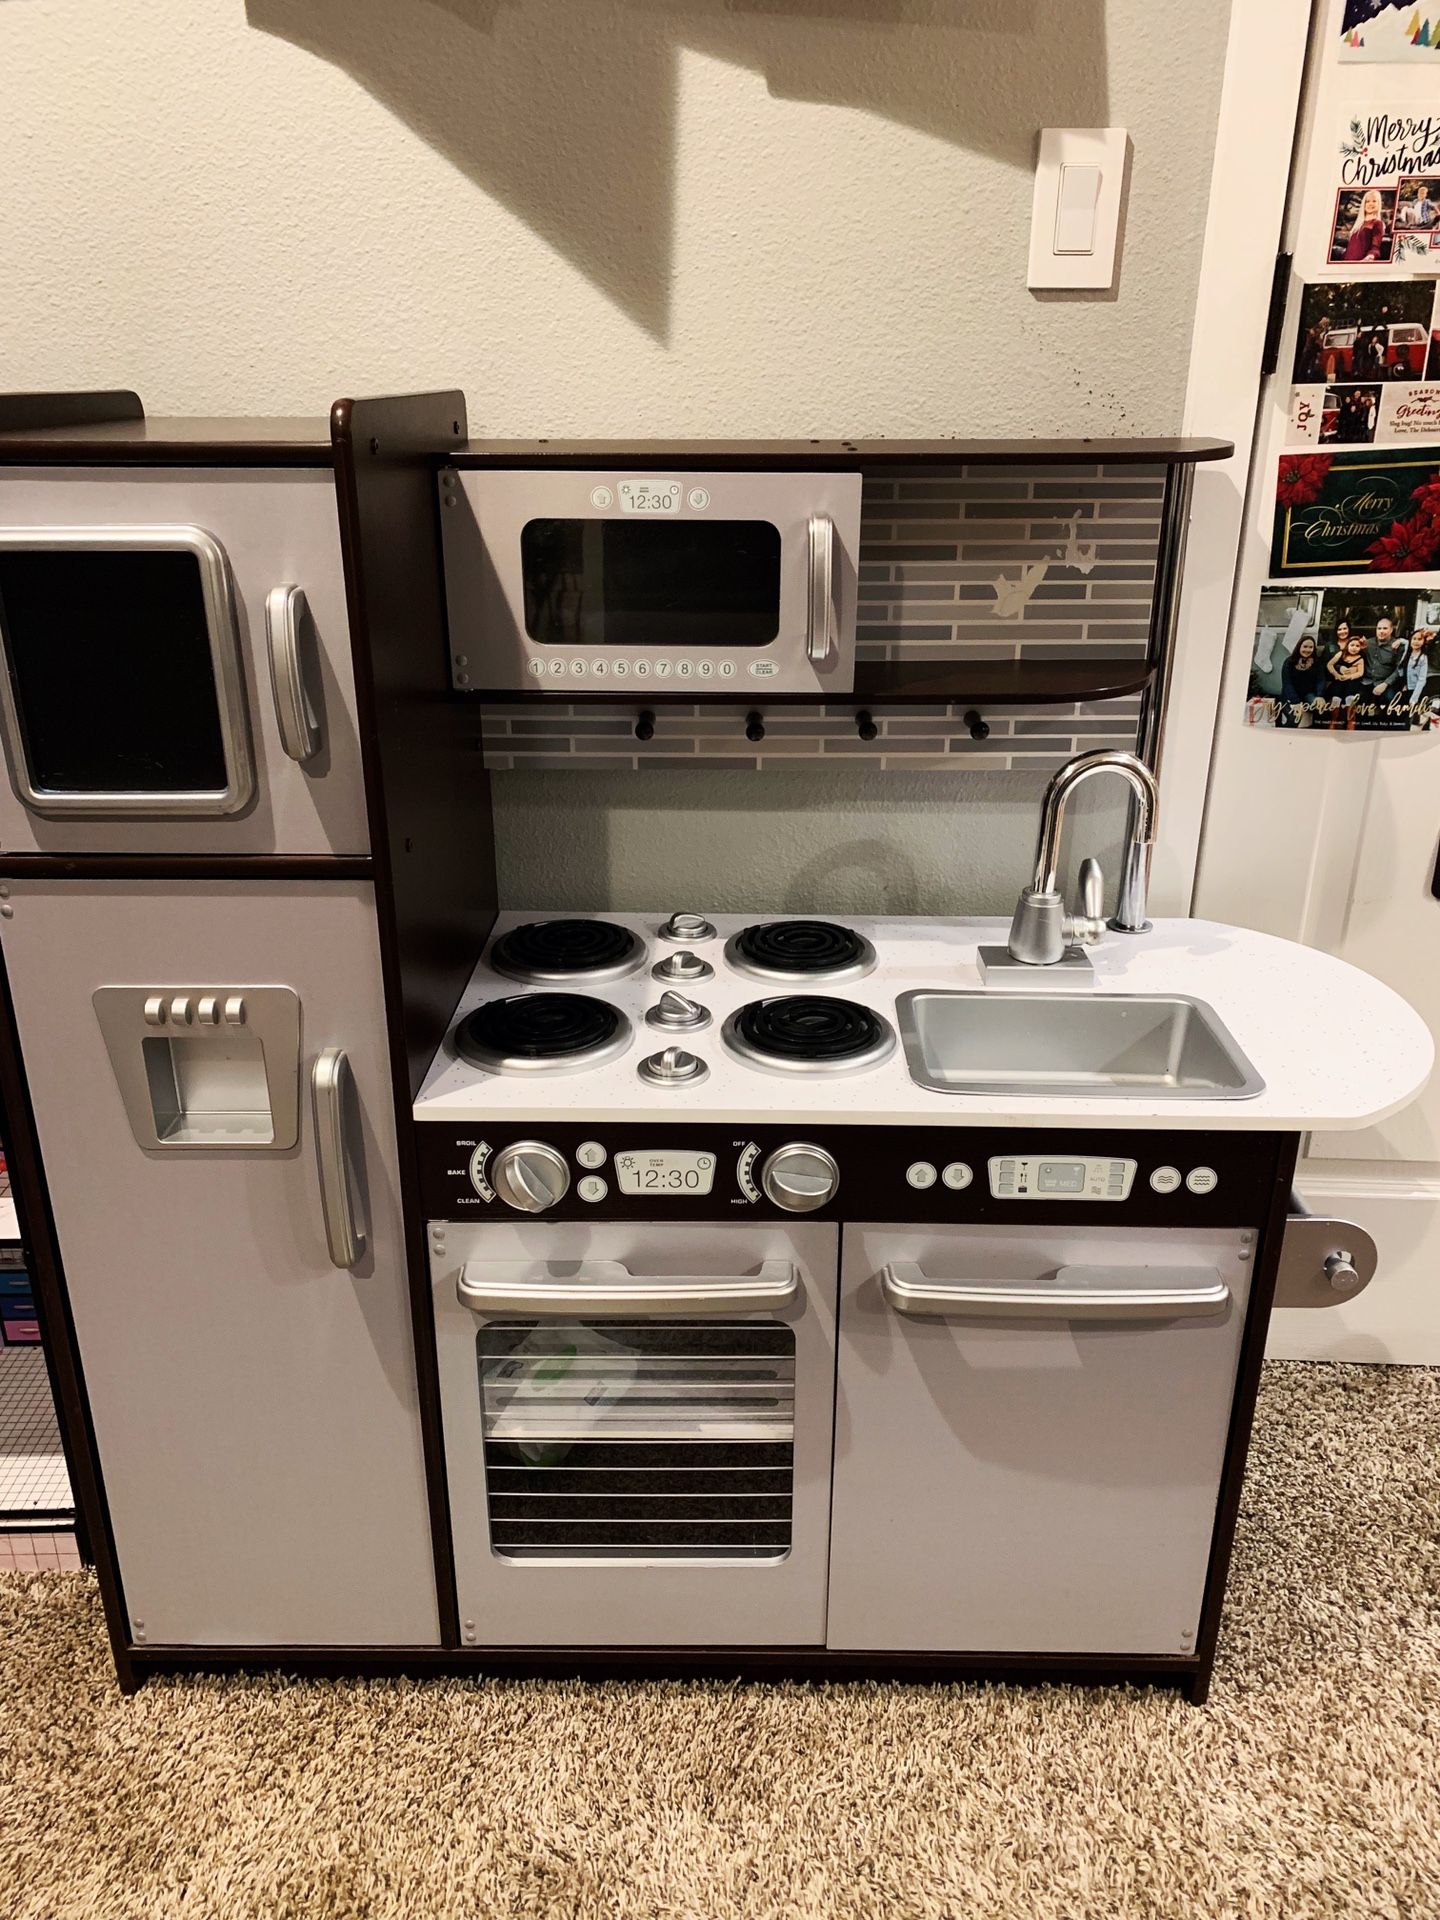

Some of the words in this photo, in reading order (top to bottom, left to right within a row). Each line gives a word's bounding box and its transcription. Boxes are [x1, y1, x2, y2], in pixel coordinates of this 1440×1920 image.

[1366, 114, 1440, 153] Merry
[1297, 401, 1310, 431] JOY
[630, 494, 672, 510] 12:30
[1342, 489, 1394, 518] Merry
[1300, 514, 1380, 542] Christmas
[632, 1169, 700, 1188] 12:30
